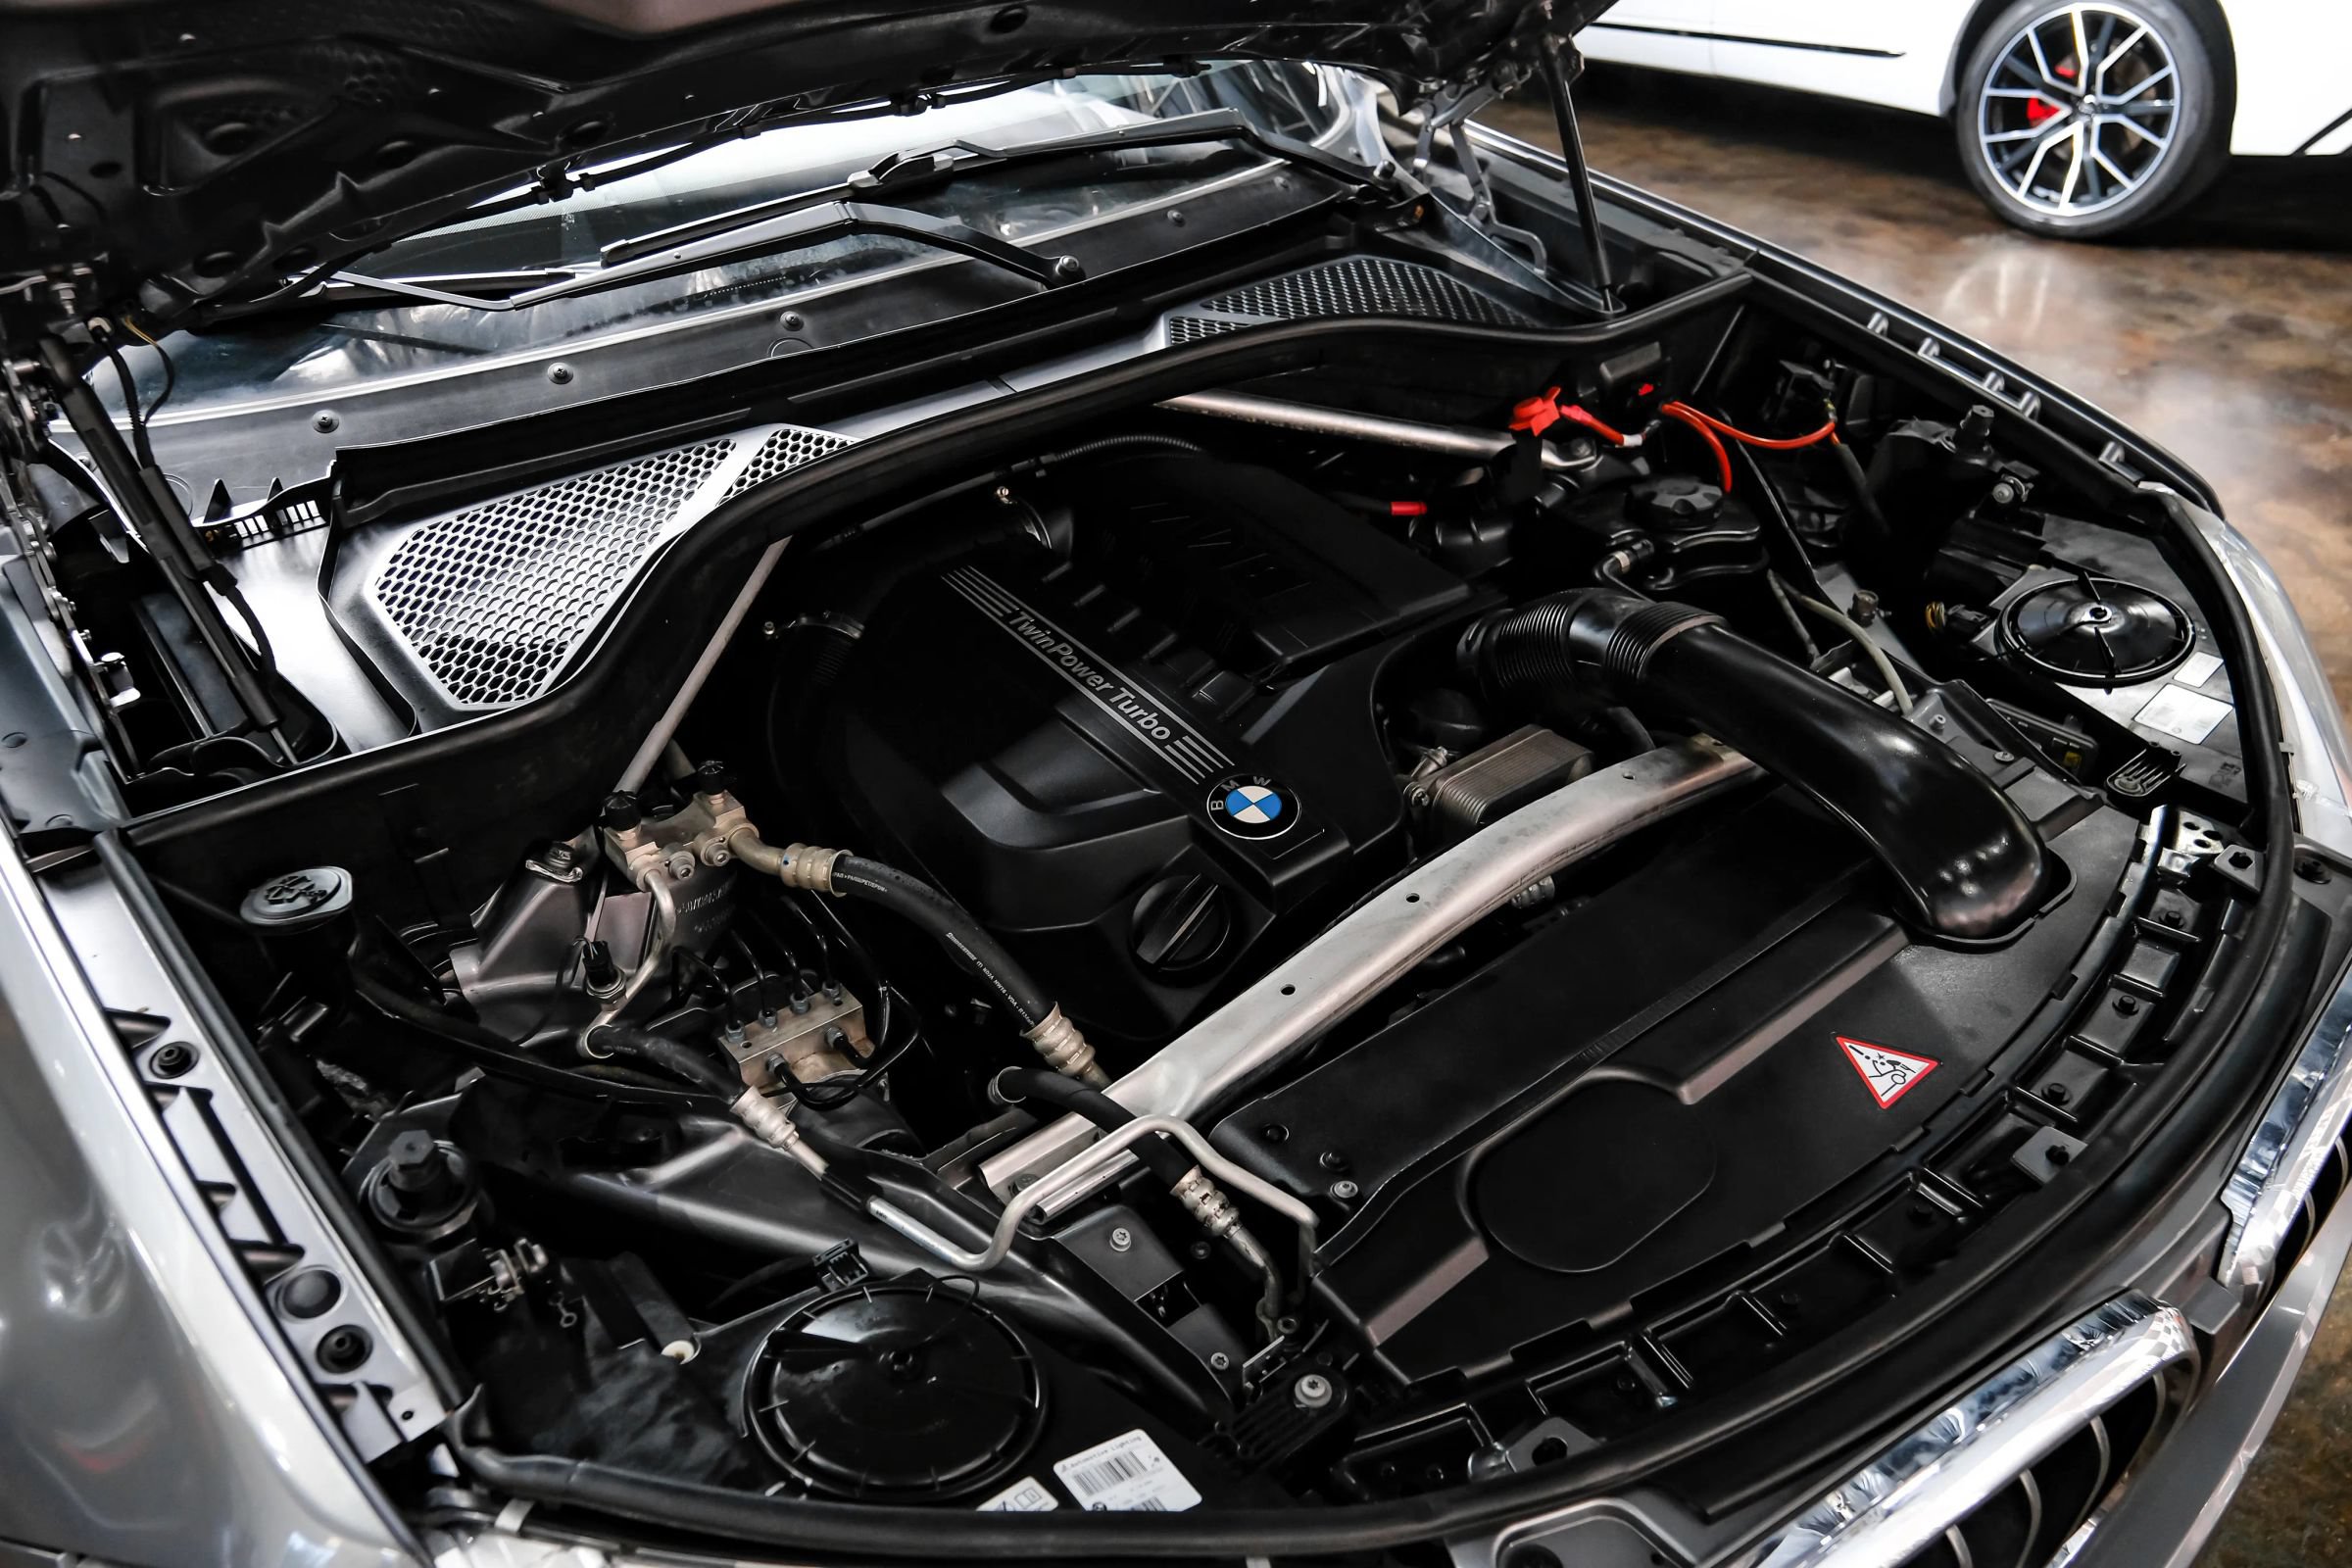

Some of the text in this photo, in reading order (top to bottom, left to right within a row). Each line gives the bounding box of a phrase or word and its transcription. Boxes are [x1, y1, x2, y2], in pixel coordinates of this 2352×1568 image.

[1009, 611, 1171, 740] TwinPower Turbo
[1210, 776, 1272, 810] BMW
